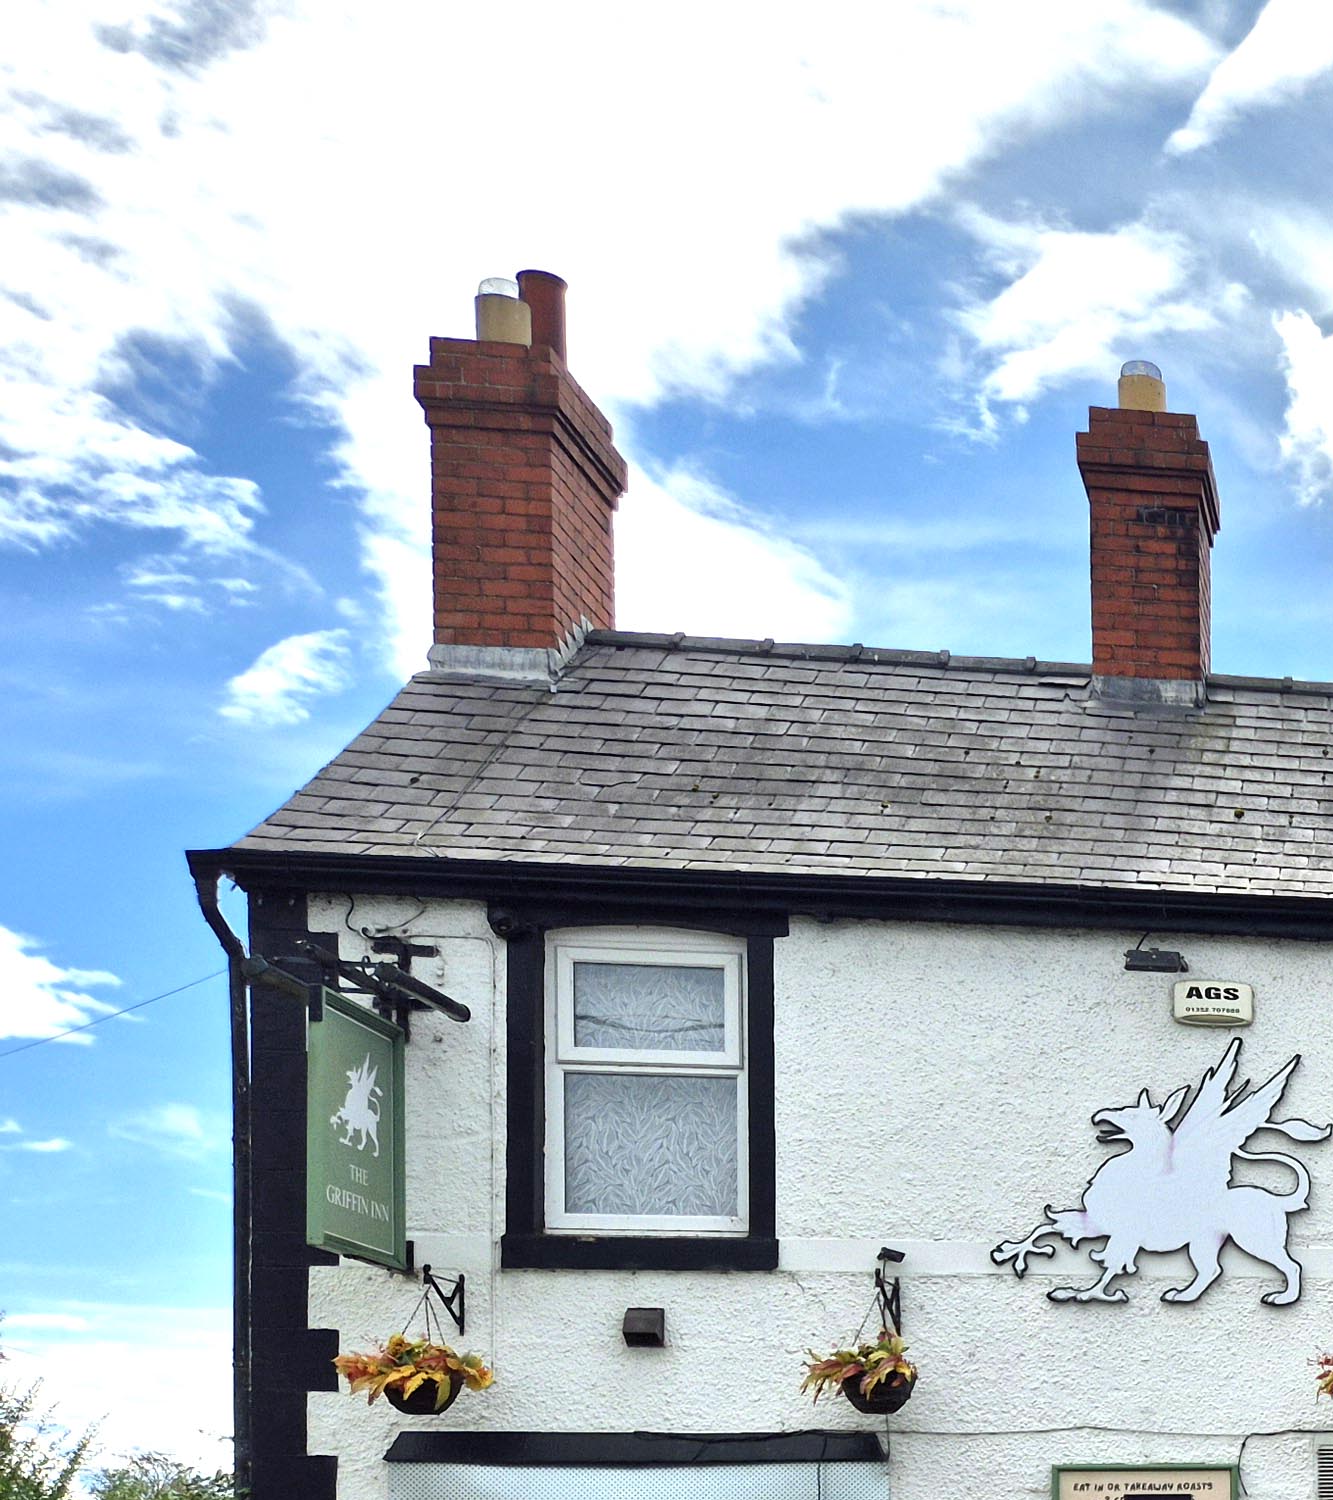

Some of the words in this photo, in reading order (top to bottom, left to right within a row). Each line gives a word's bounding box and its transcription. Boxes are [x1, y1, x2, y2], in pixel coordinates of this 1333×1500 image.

[1185, 986, 1240, 1001] AGS
[349, 1164, 369, 1186] THE
[326, 1184, 369, 1216] GRIFFIN
[370, 1200, 390, 1222] INN
[1073, 1483, 1090, 1491] EAT
[1094, 1483, 1104, 1491] IN
[1107, 1482, 1121, 1491] OR
[1124, 1482, 1174, 1491] TAKEAWAY
[1176, 1482, 1213, 1491] ROASTS
